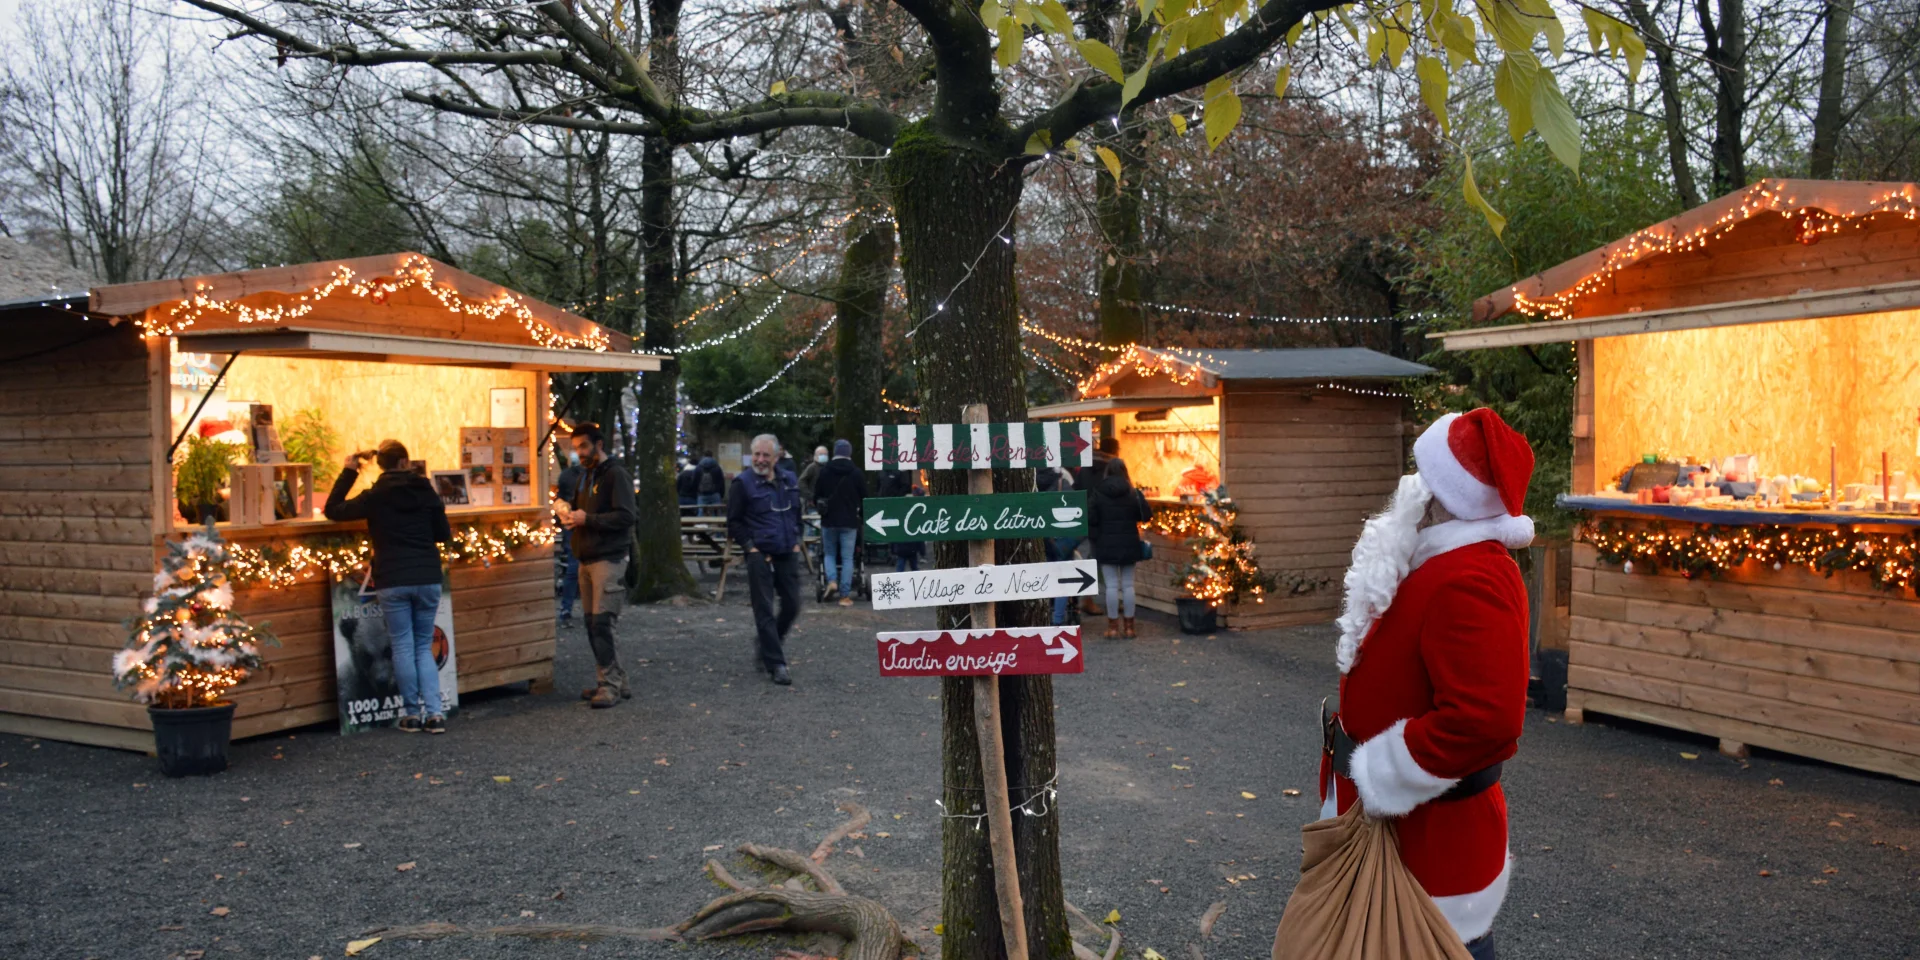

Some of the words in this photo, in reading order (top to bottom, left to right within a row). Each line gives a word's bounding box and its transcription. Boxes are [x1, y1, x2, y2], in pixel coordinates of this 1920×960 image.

[868, 434, 938, 464] Etable
[947, 445, 980, 462] des
[986, 435, 1054, 462] Rennes
[904, 502, 951, 536] Café
[955, 507, 989, 531] des
[994, 507, 1046, 531] lutins
[909, 576, 965, 602] Village
[974, 573, 995, 595] de
[1004, 569, 1050, 594] Noël
[882, 641, 942, 671] Jardin
[946, 644, 1018, 674] enneigé
[348, 699, 379, 714] 1000
